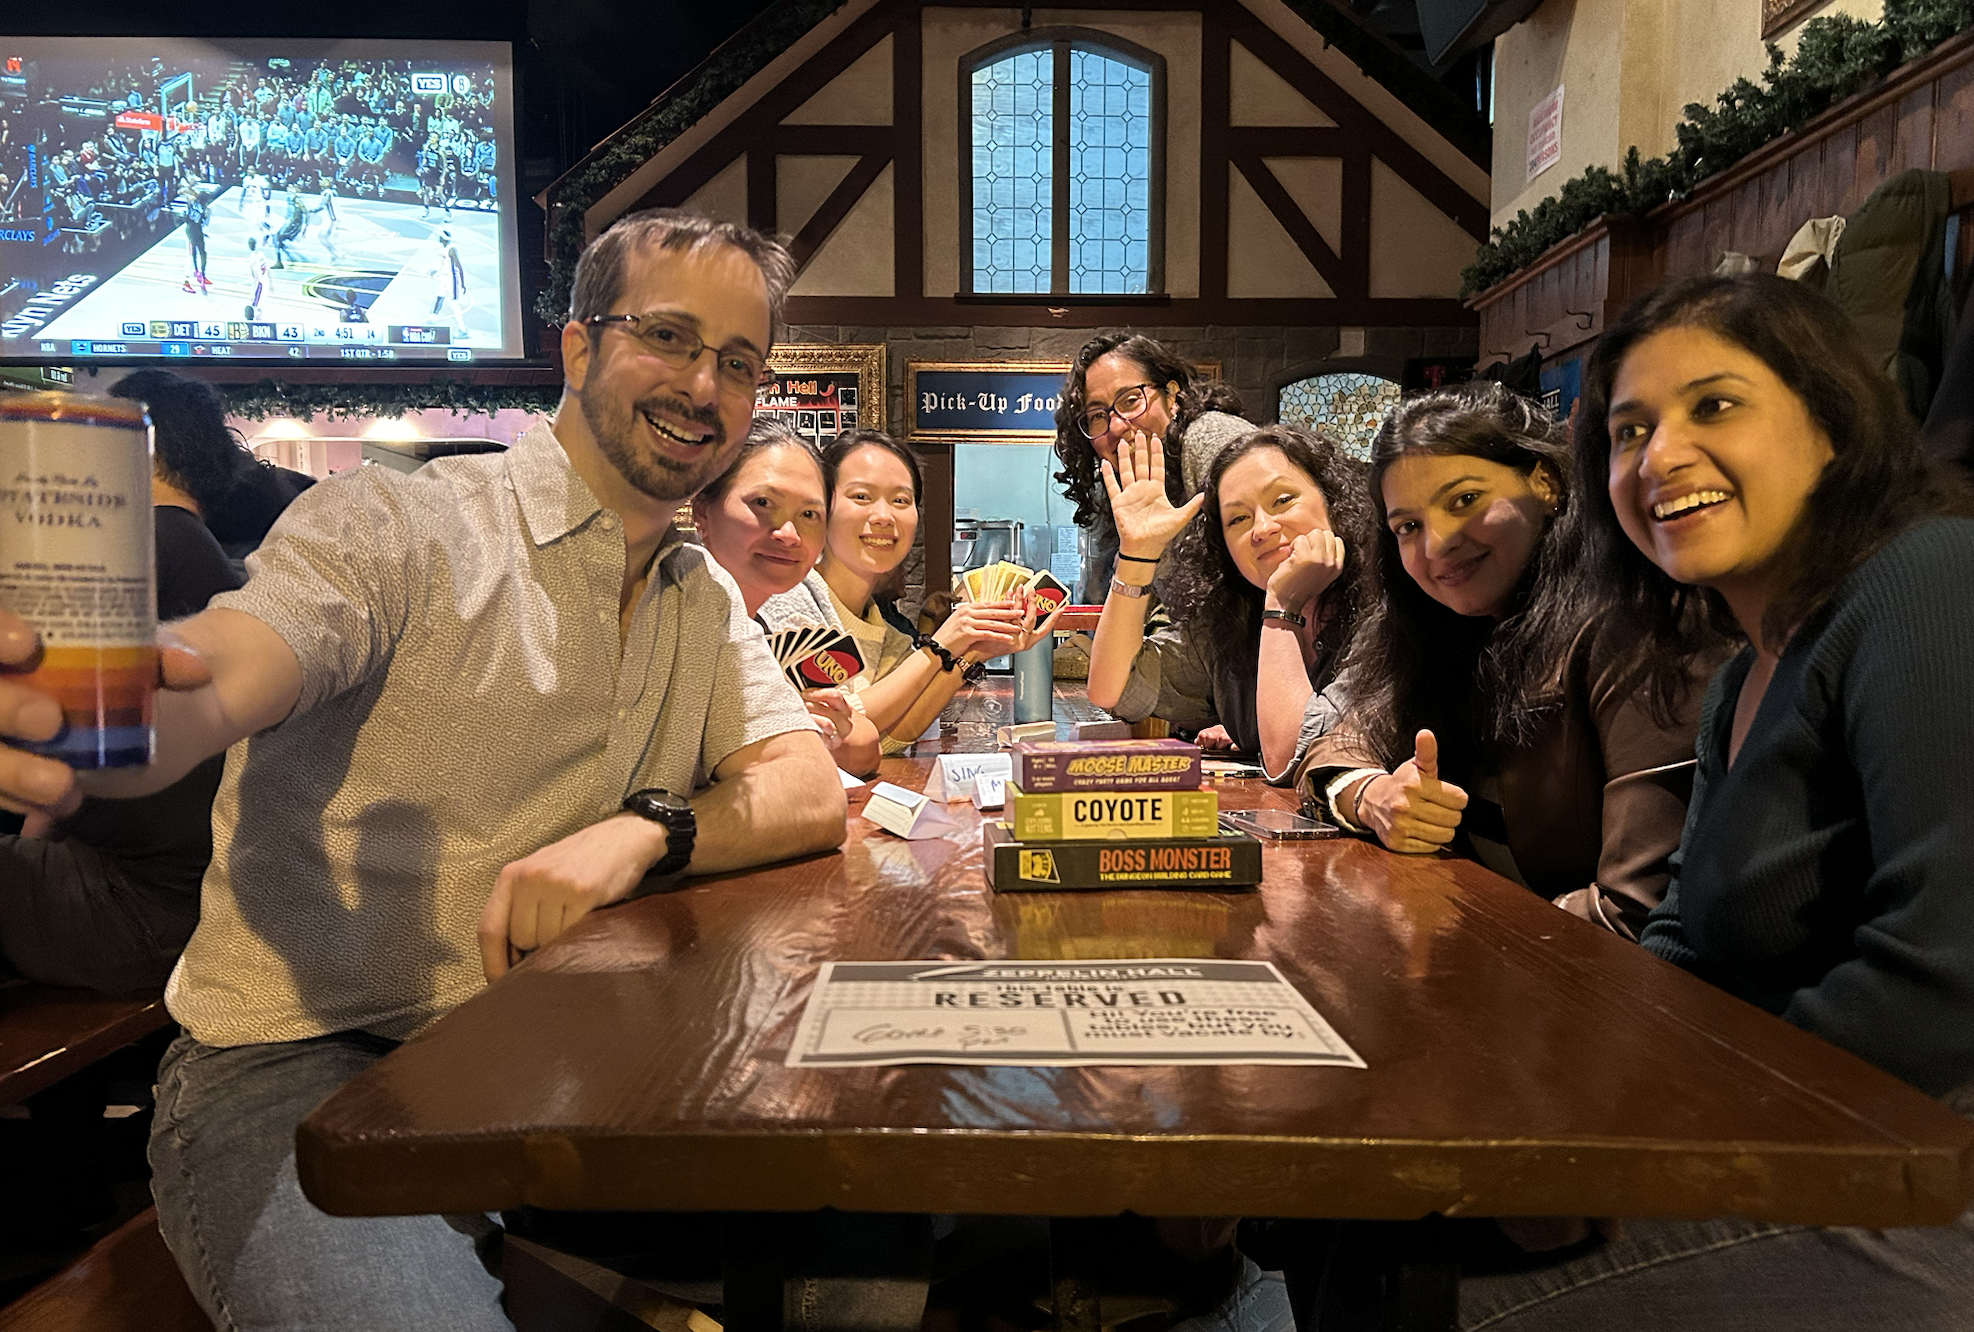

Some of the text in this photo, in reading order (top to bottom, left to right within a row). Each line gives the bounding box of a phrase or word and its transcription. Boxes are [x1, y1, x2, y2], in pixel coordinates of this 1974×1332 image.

[417, 78, 442, 90] YES
[0, 229, 35, 242] RCLAYS
[124, 325, 142, 333] YES
[173, 323, 191, 337] DET
[204, 325, 220, 337] 45
[252, 325, 298, 339] BKN 43
[335, 328, 354, 339] 4:51
[367, 329, 375, 339] 14
[93, 344, 180, 354] HORNETS 29
[211, 346, 300, 357] HEAT 42
[340, 348, 355, 358] 1ST
[786, 380, 817, 395] Hell
[754, 397, 798, 407] FLAME
[921, 392, 1008, 414] Pick-Up
[814, 650, 848, 684] UNO
[1067, 755, 1192, 776] MOOSE MASTER
[1074, 798, 1163, 822] COYOTE
[1099, 847, 1232, 873] BOSS MONSTER
[1099, 872, 1116, 881] THE
[1210, 870, 1232, 879] GAME
[983, 967, 1204, 978] ZEPPELIN HALL
[934, 991, 1187, 1008] RESERVED
